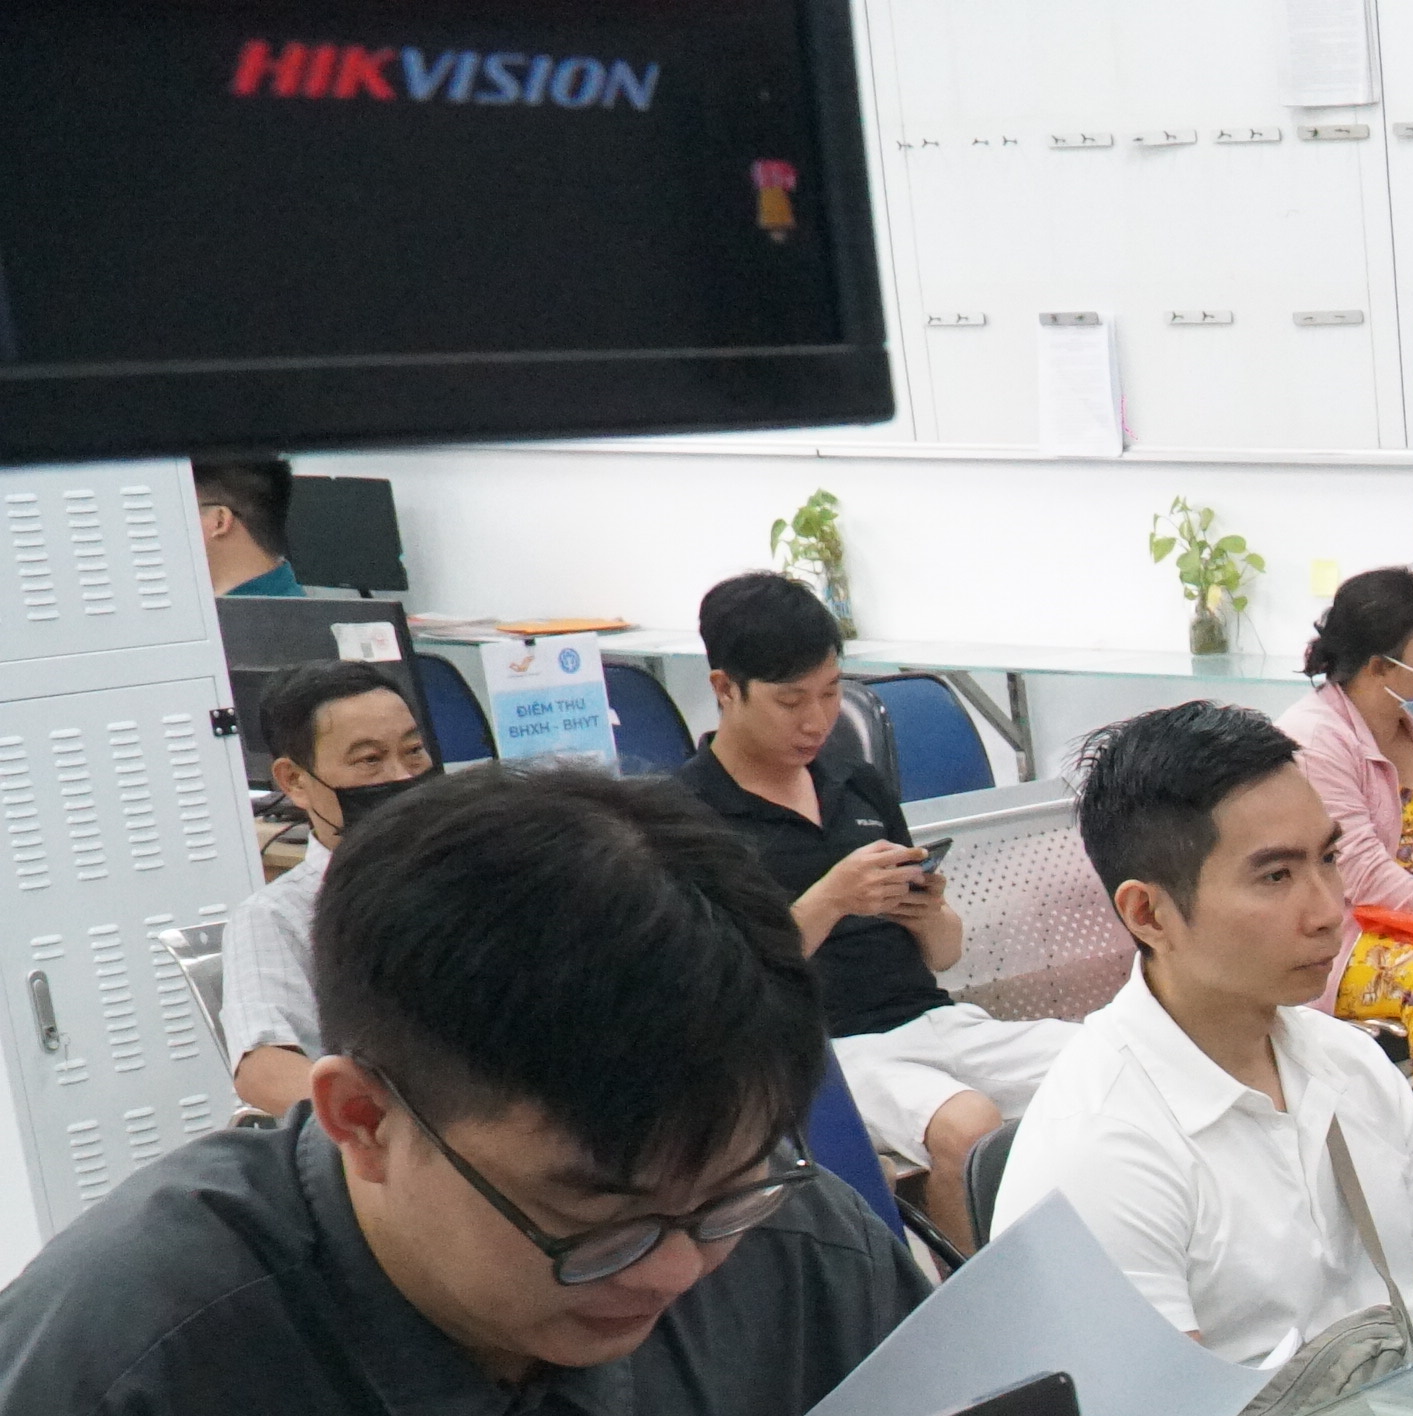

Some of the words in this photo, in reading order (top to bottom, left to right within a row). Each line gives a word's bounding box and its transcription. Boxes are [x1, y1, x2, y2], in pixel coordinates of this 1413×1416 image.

[232, 38, 661, 112] HIKVISION
[556, 698, 585, 711] THU
[509, 721, 550, 738] BHXH
[563, 715, 600, 731] BHYT
